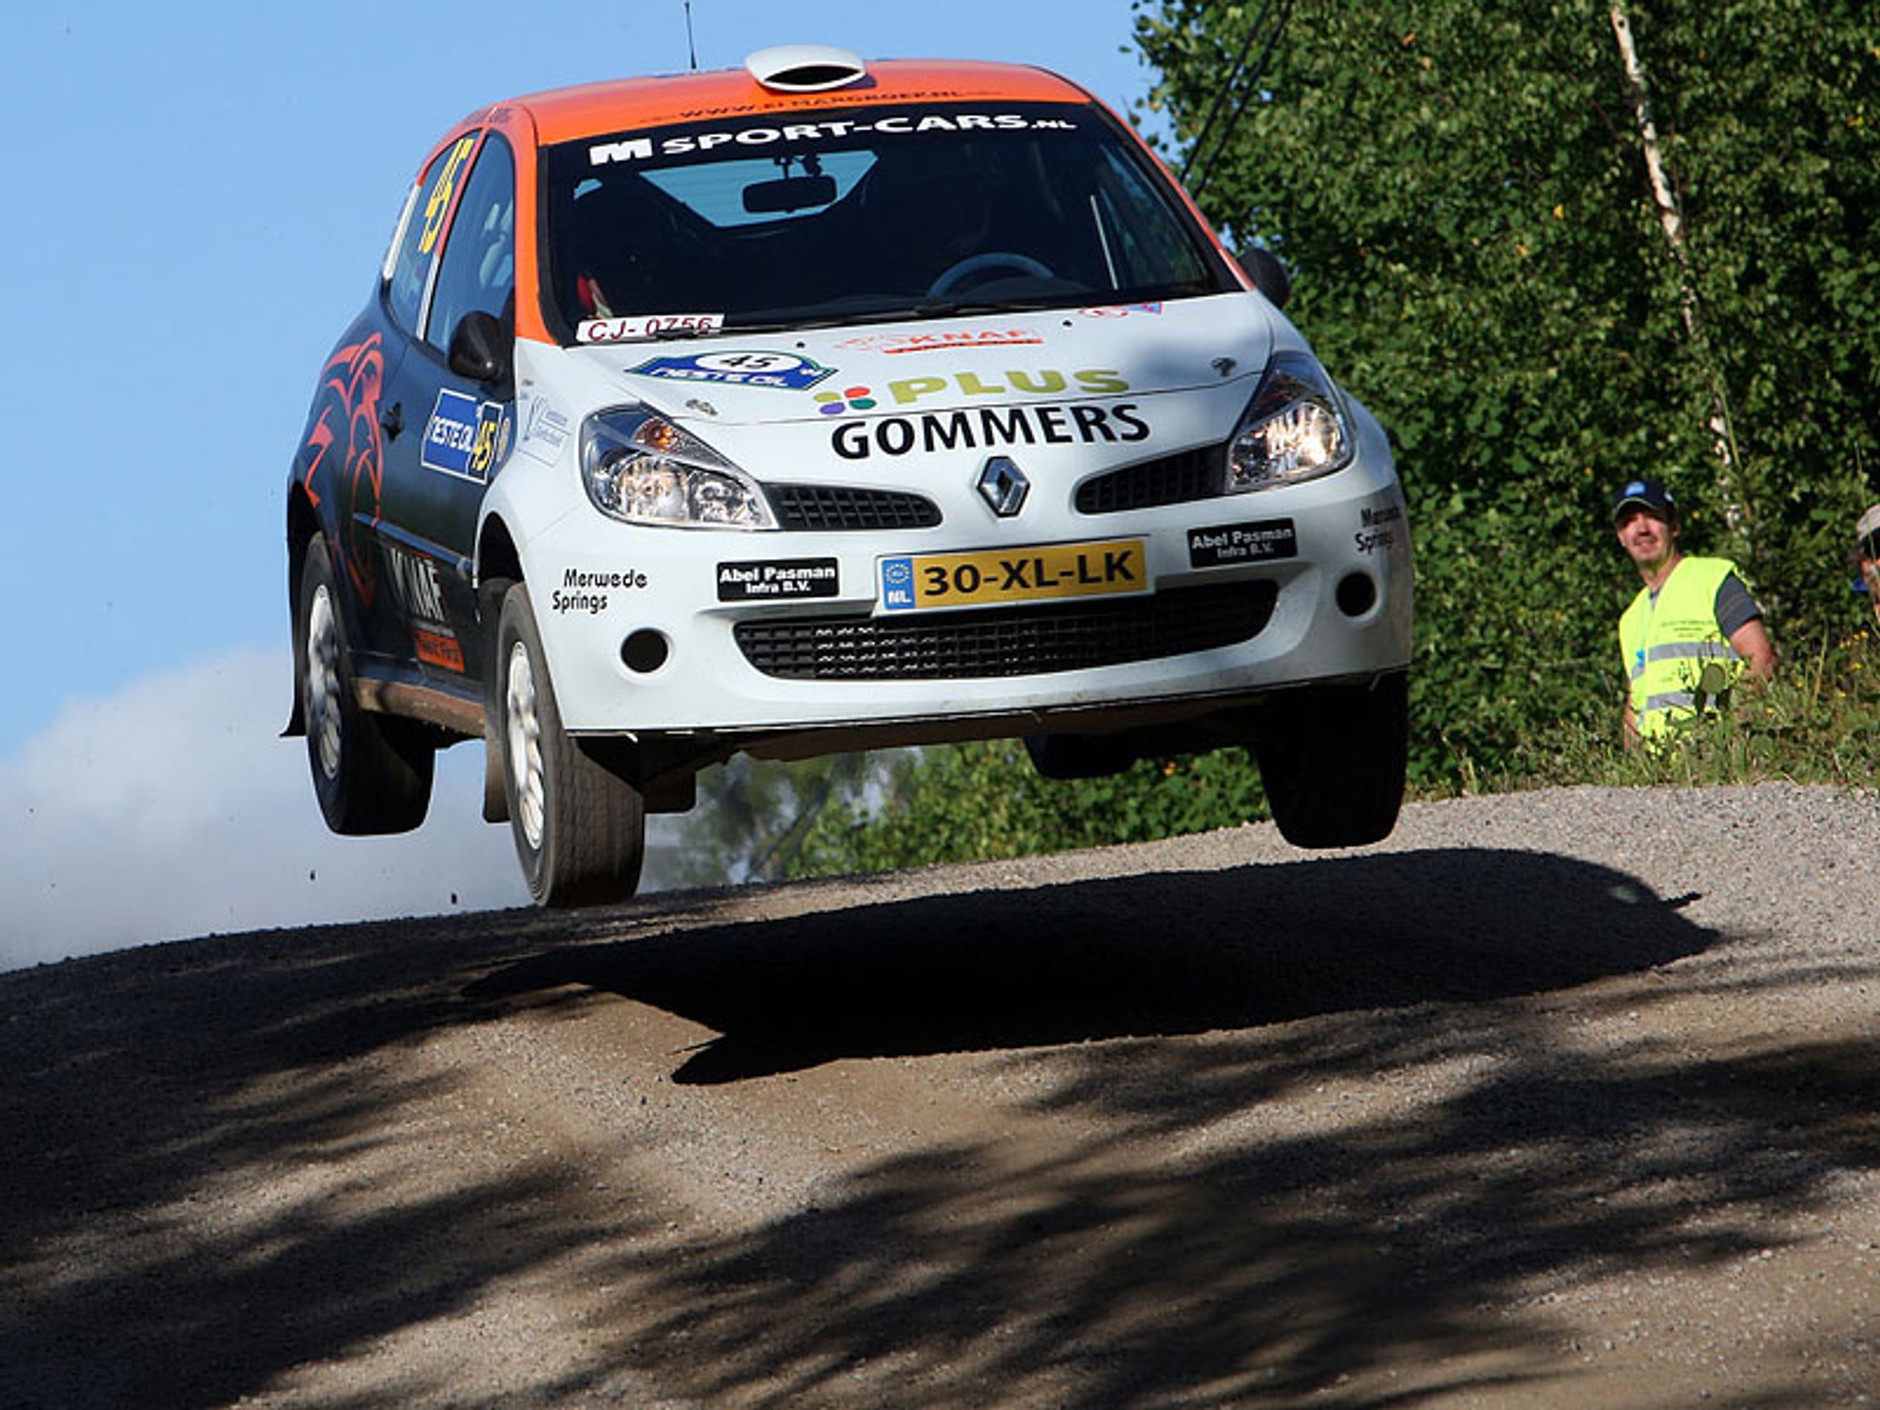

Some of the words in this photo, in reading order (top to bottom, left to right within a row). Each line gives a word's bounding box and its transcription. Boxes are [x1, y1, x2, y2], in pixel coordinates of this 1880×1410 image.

[719, 354, 777, 369] 45
[888, 369, 1130, 405] PLUS
[831, 403, 1151, 460] GOMMERS
[1191, 532, 1229, 549] Abel
[1232, 527, 1294, 544] Pasman
[1216, 547, 1247, 559] Infra
[563, 568, 649, 589] Merwede
[719, 568, 761, 584] Abel
[763, 565, 837, 582] Pasman
[923, 550, 1135, 597] 30-XL-LK
[745, 580, 780, 595] Infra
[782, 579, 812, 593] B.V.
[887, 590, 912, 604] NL
[551, 590, 609, 615] Springs
